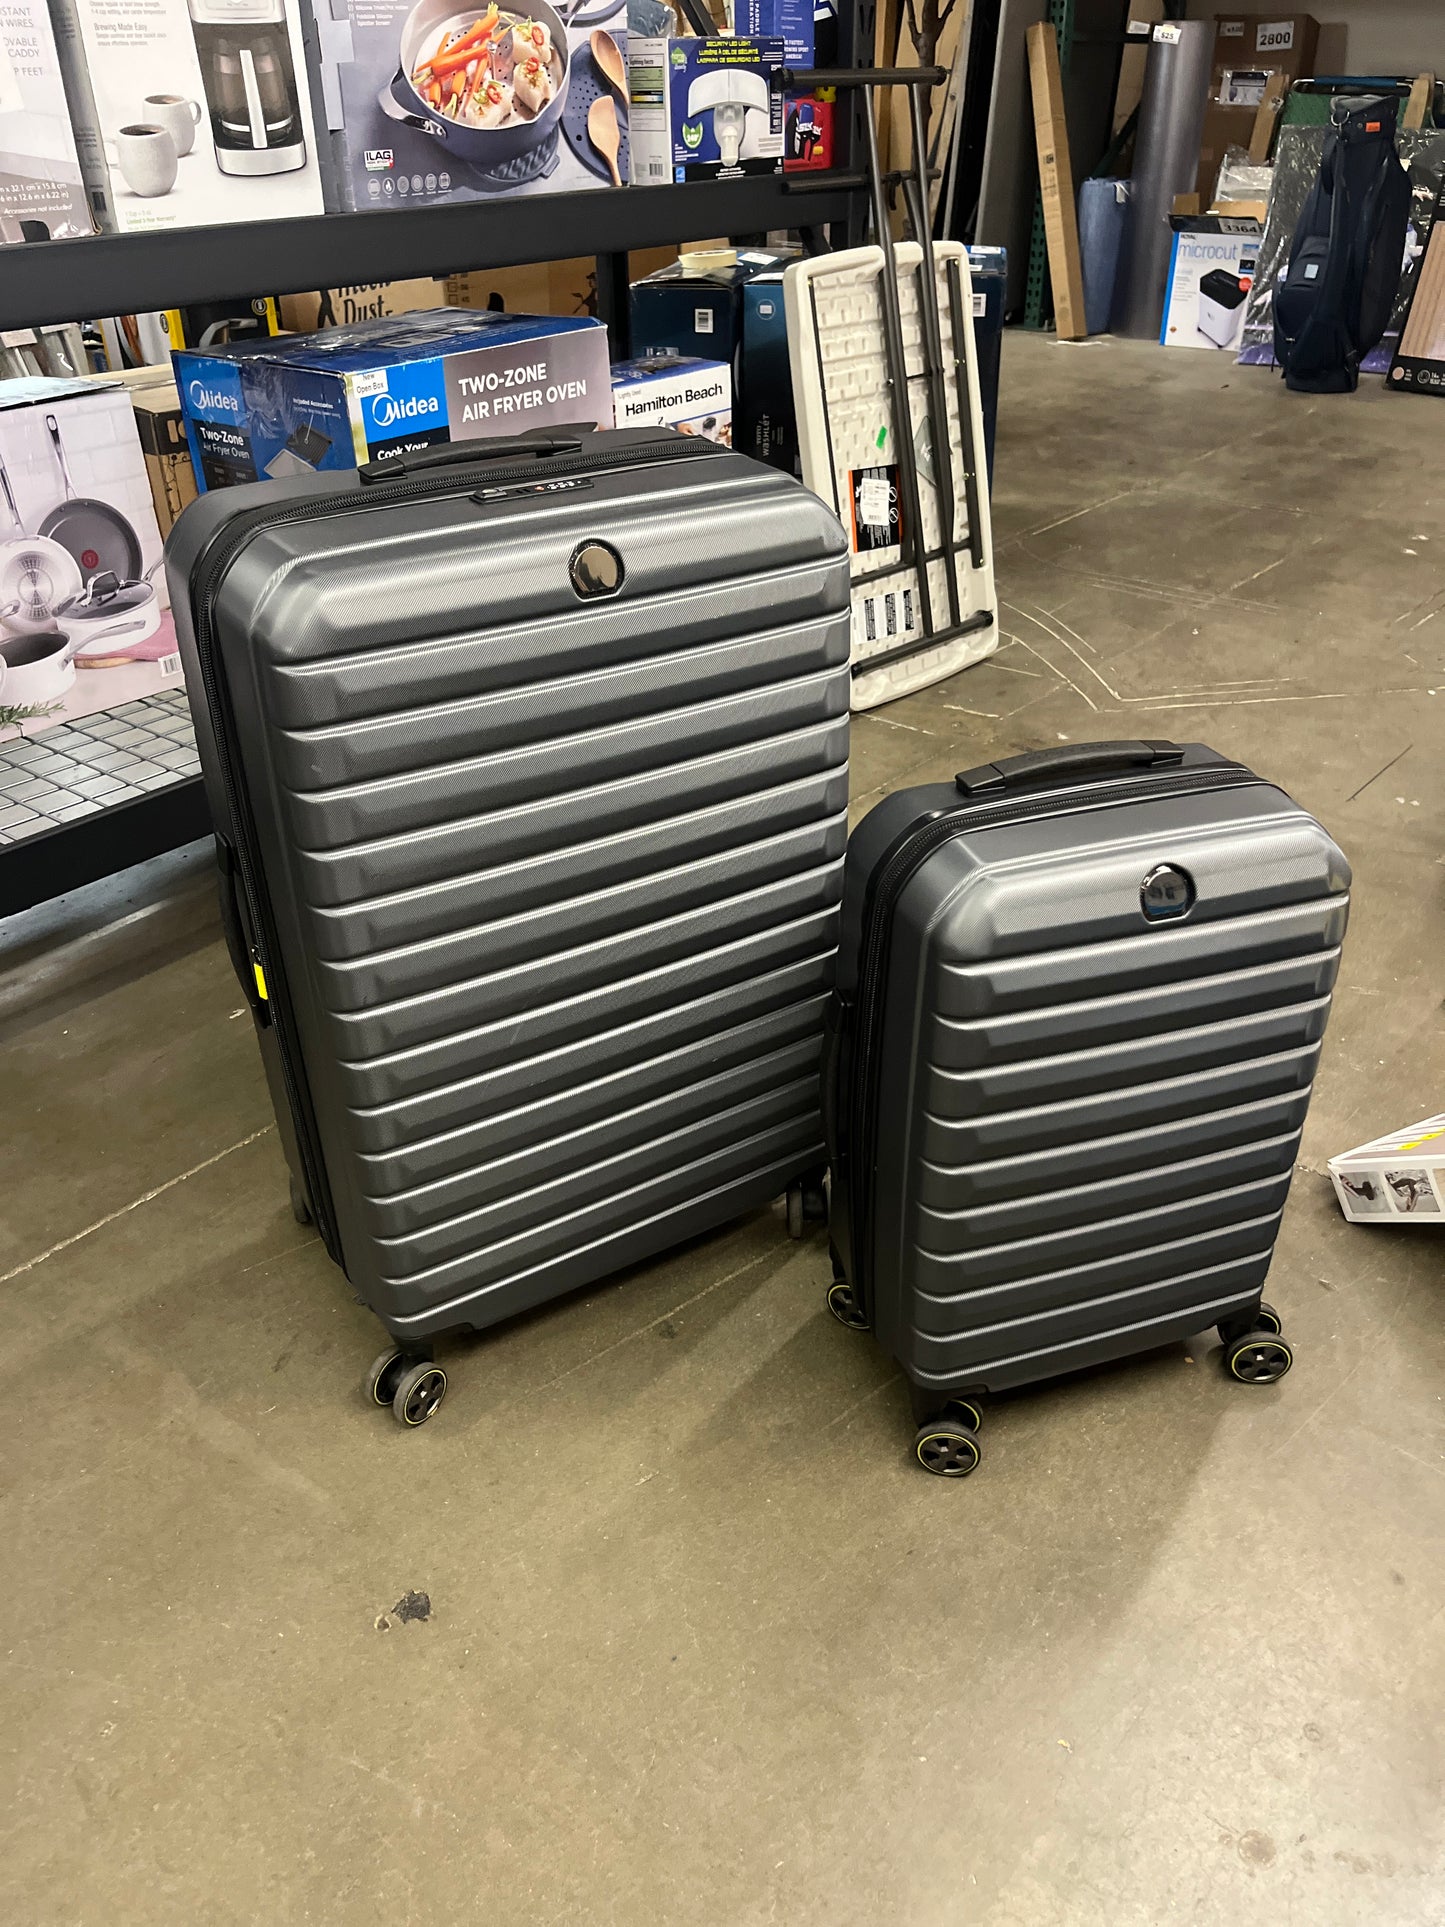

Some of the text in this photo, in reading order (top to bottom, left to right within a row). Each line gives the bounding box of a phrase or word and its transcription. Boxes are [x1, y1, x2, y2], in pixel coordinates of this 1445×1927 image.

[6, 19, 34, 28] WIRES
[94, 22, 148, 32] Brewing Made Easy
[1160, 32, 1174, 40] $25
[1259, 32, 1291, 46] 2800
[8, 49, 39, 58] CADDY
[22, 67, 43, 76] FEET
[366, 151, 391, 160] ILAG
[49, 203, 72, 211] included
[1225, 224, 1257, 233] 3364
[1179, 243, 1238, 260] microcut
[458, 363, 547, 396] TWO-ZONE
[356, 382, 384, 394] Open Box
[190, 380, 238, 411] Midea
[462, 379, 587, 423] AIR FRYER OVEN
[626, 383, 723, 416] Hamilton Beach
[372, 393, 439, 426] Midea
[200, 427, 244, 446] Two-Zone
[212, 443, 230, 456] Fryer
[231, 447, 250, 459] Oven
